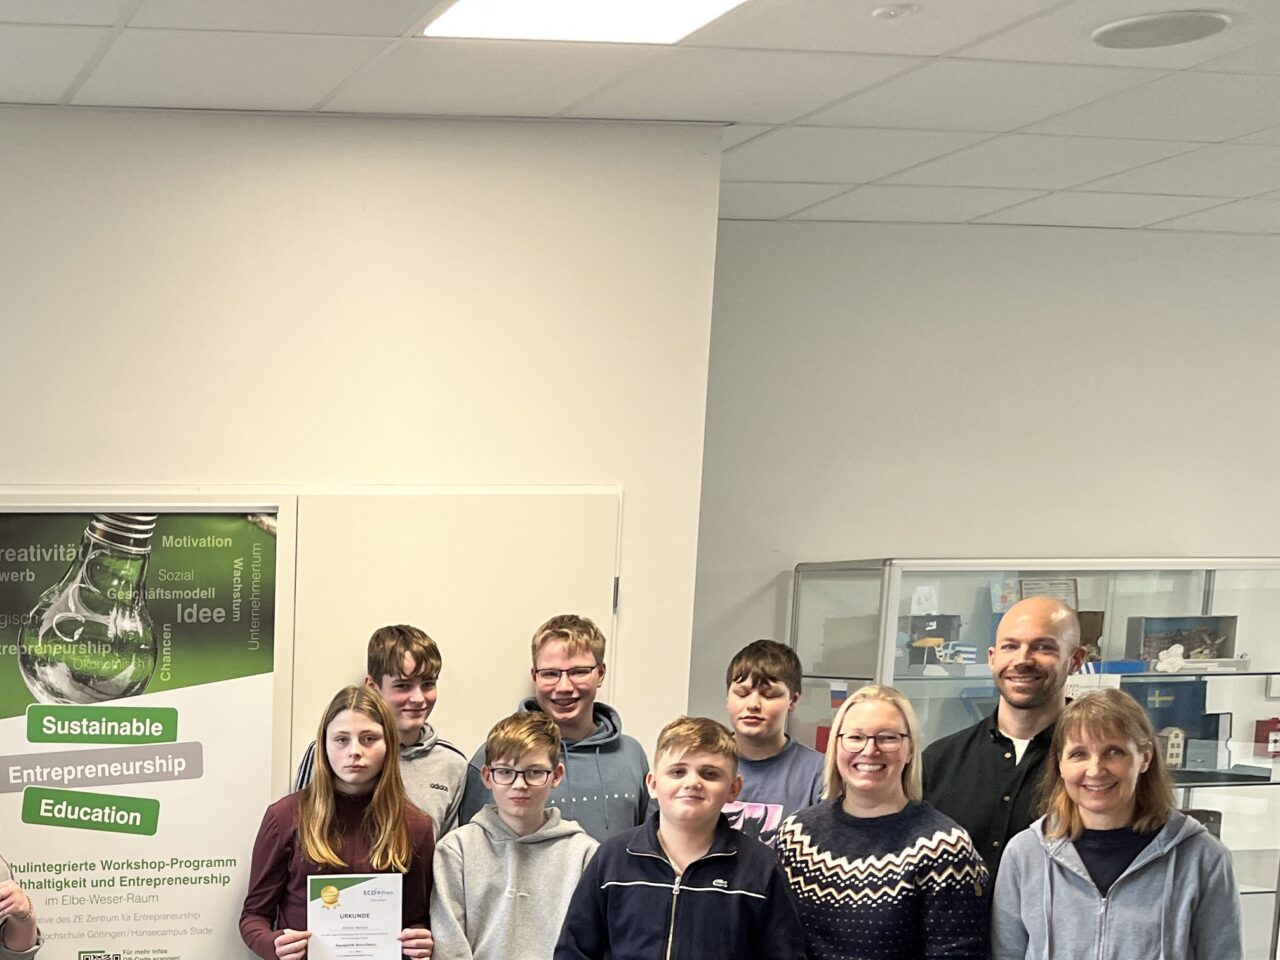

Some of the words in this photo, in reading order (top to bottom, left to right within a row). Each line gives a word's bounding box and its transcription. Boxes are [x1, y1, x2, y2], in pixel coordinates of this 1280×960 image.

[162, 535, 232, 549] Motivation
[158, 568, 194, 581] Sozial
[107, 587, 215, 600] Geschäftsmodell
[233, 557, 243, 622] Wachstum
[248, 542, 262, 650] Unternehmertum
[176, 603, 226, 623] Idee
[160, 623, 171, 682] Chancen
[42, 715, 163, 737] Sustainable
[8, 754, 187, 784] Entrepreneurship
[39, 799, 142, 826] Education
[11, 861, 96, 875] hulintegrierte
[101, 857, 237, 872] Workshop-Programm
[19, 877, 87, 891] hhaltigkeit
[91, 877, 115, 888] und
[120, 873, 231, 889] Entrepreneurship
[45, 896, 58, 906] im
[62, 893, 159, 906] Elbe-Weser-Raum
[86, 914, 119, 923] Zentrum
[133, 912, 201, 922] Entrepreneurship
[190, 927, 213, 935] Stade
